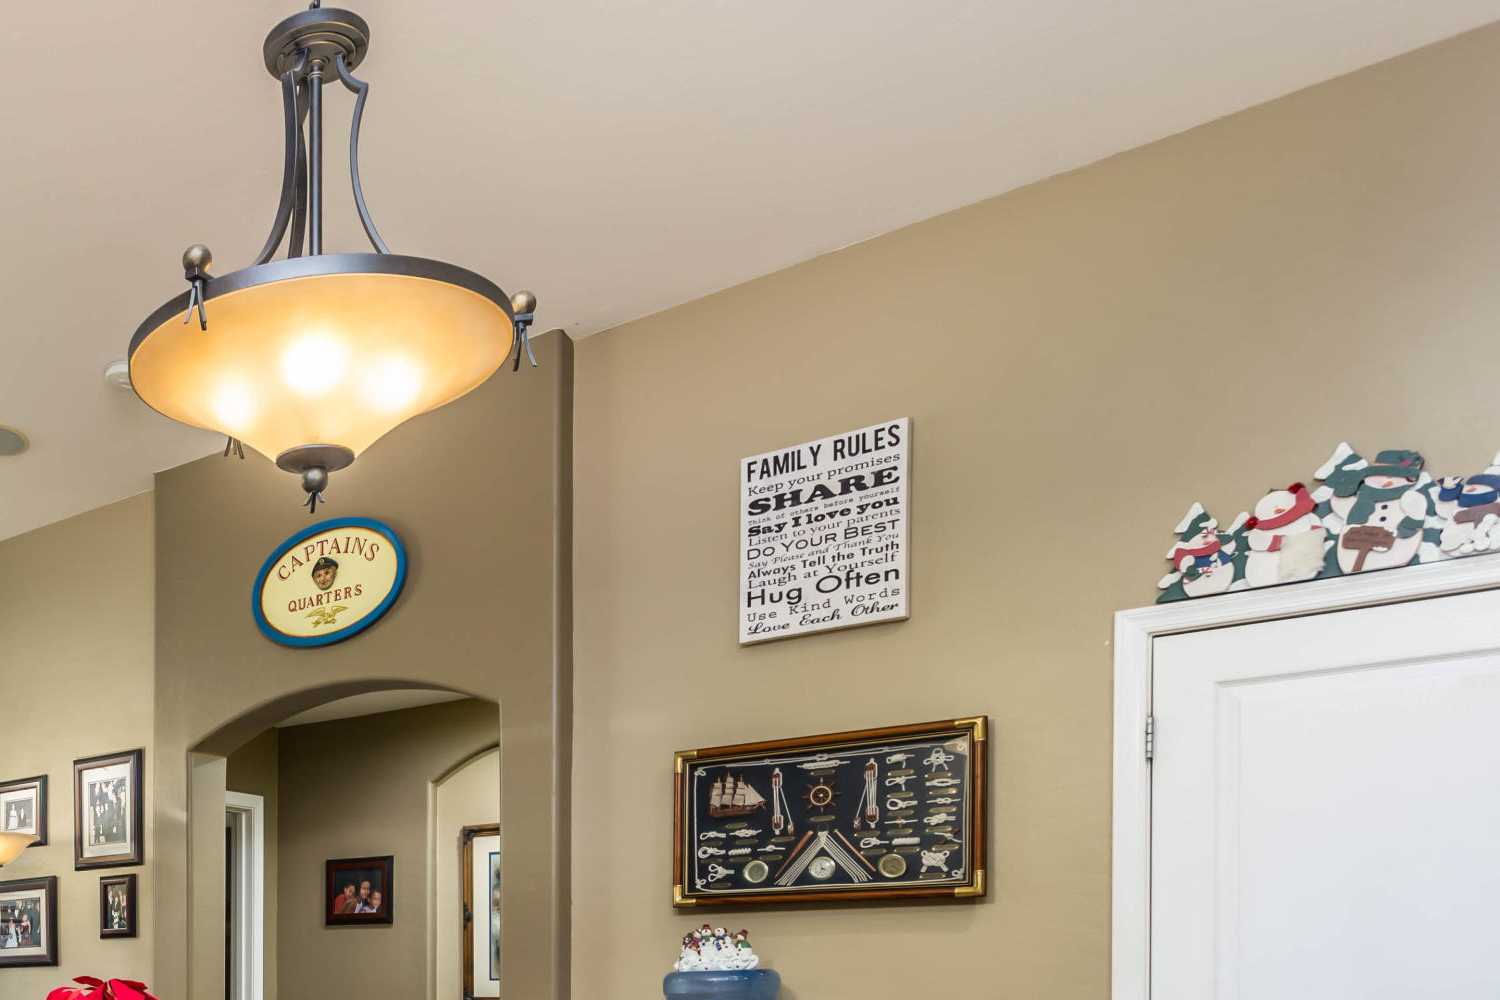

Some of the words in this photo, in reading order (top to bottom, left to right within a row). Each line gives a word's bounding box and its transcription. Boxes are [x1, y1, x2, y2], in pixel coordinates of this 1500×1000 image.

[747, 444, 821, 483] FAMILY
[833, 424, 900, 461] RULES
[748, 482, 784, 497] Keep
[788, 472, 823, 489] your
[827, 453, 900, 480] promises
[748, 466, 900, 516] SHARE
[748, 517, 771, 525] Think
[775, 512, 785, 520] of
[790, 506, 819, 517] others
[823, 498, 853, 509] before
[858, 486, 900, 502] yourself
[748, 521, 788, 538] Say
[791, 516, 802, 528] I
[805, 507, 851, 525] love
[856, 496, 900, 515] you
[747, 546, 775, 560] DO
[781, 533, 837, 552] YOUR
[844, 519, 900, 540] BEST
[748, 533, 788, 547] Listen
[792, 529, 806, 537] to
[810, 520, 842, 534] your
[846, 509, 900, 528] parents
[276, 536, 380, 581] CAPTAINS
[748, 559, 768, 570] Say
[771, 553, 805, 564] Please
[808, 545, 833, 556] and
[833, 538, 872, 552] Thank
[877, 532, 899, 543] You
[748, 562, 796, 580] Always
[800, 554, 826, 569] Tell
[831, 551, 855, 563] the
[860, 541, 900, 557] Truth
[748, 571, 797, 589] Laugh
[803, 570, 819, 579] at
[825, 551, 899, 574] Yourself
[287, 584, 362, 613] QUARTERS
[747, 587, 803, 608] Hug
[815, 568, 900, 594] Often
[747, 612, 778, 623] Use
[789, 598, 832, 616] Kind
[844, 587, 900, 605] Words
[748, 622, 790, 635] Love
[799, 608, 842, 626] Each
[851, 601, 899, 617] Other
